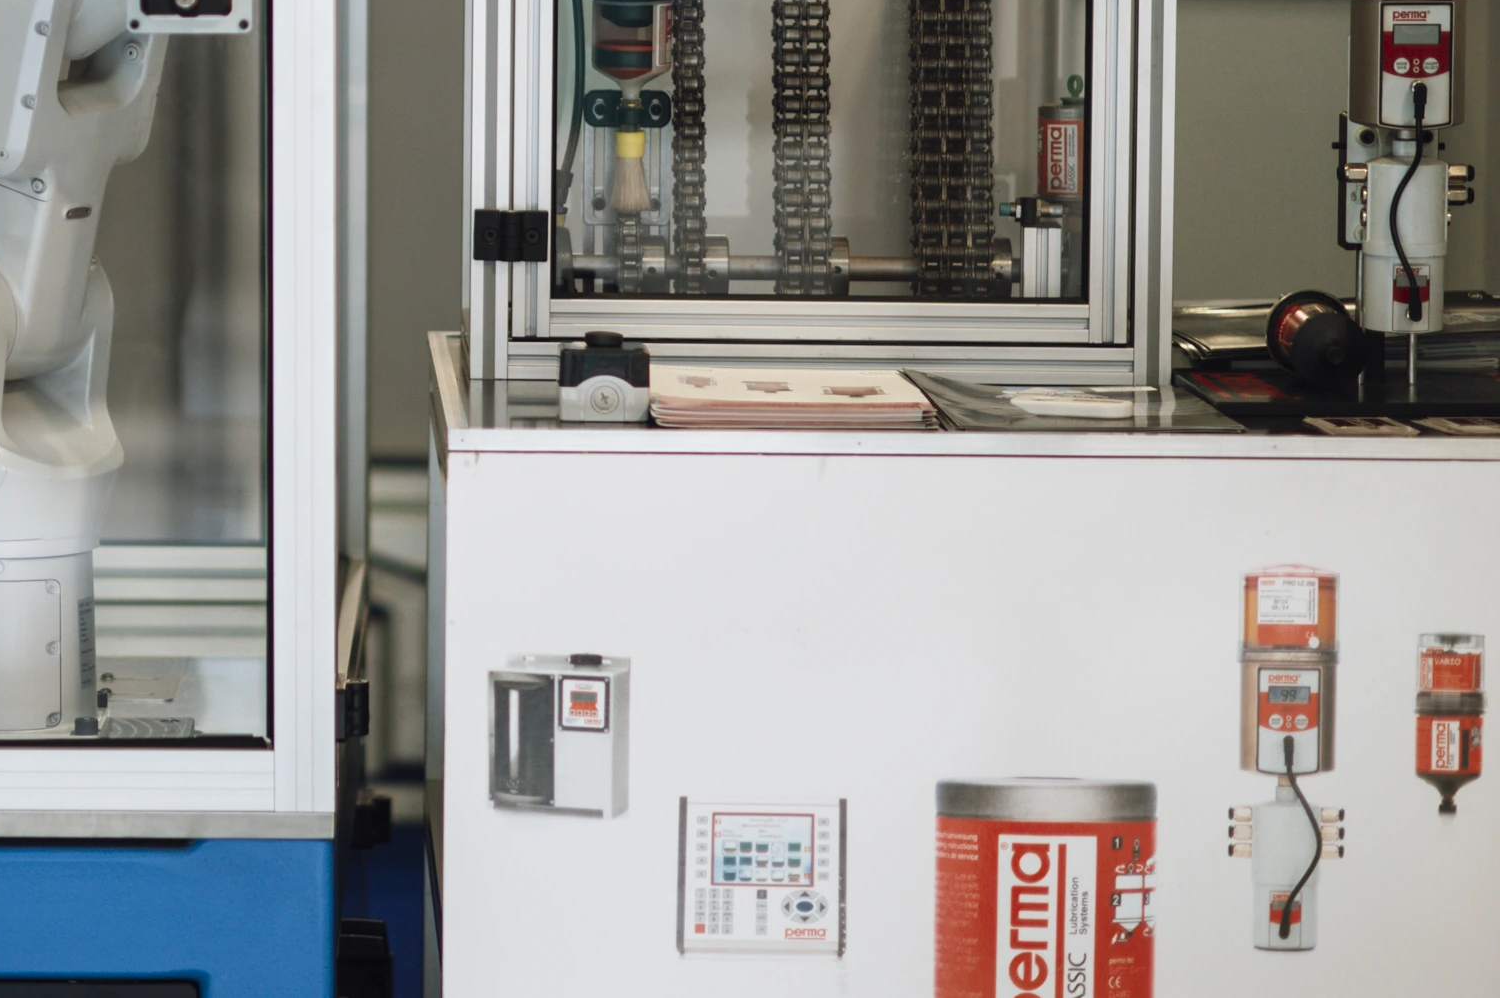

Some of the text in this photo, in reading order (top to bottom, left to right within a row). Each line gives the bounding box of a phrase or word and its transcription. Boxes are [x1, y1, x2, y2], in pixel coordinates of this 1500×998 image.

[1050, 127, 1068, 191] perma
[1068, 163, 1076, 191] CLASSIC
[1434, 658, 1461, 666] VARIO
[1436, 723, 1449, 769] perma
[1070, 877, 1079, 935] Lubrication
[1080, 891, 1089, 935] Systems
[785, 928, 827, 940] perma
